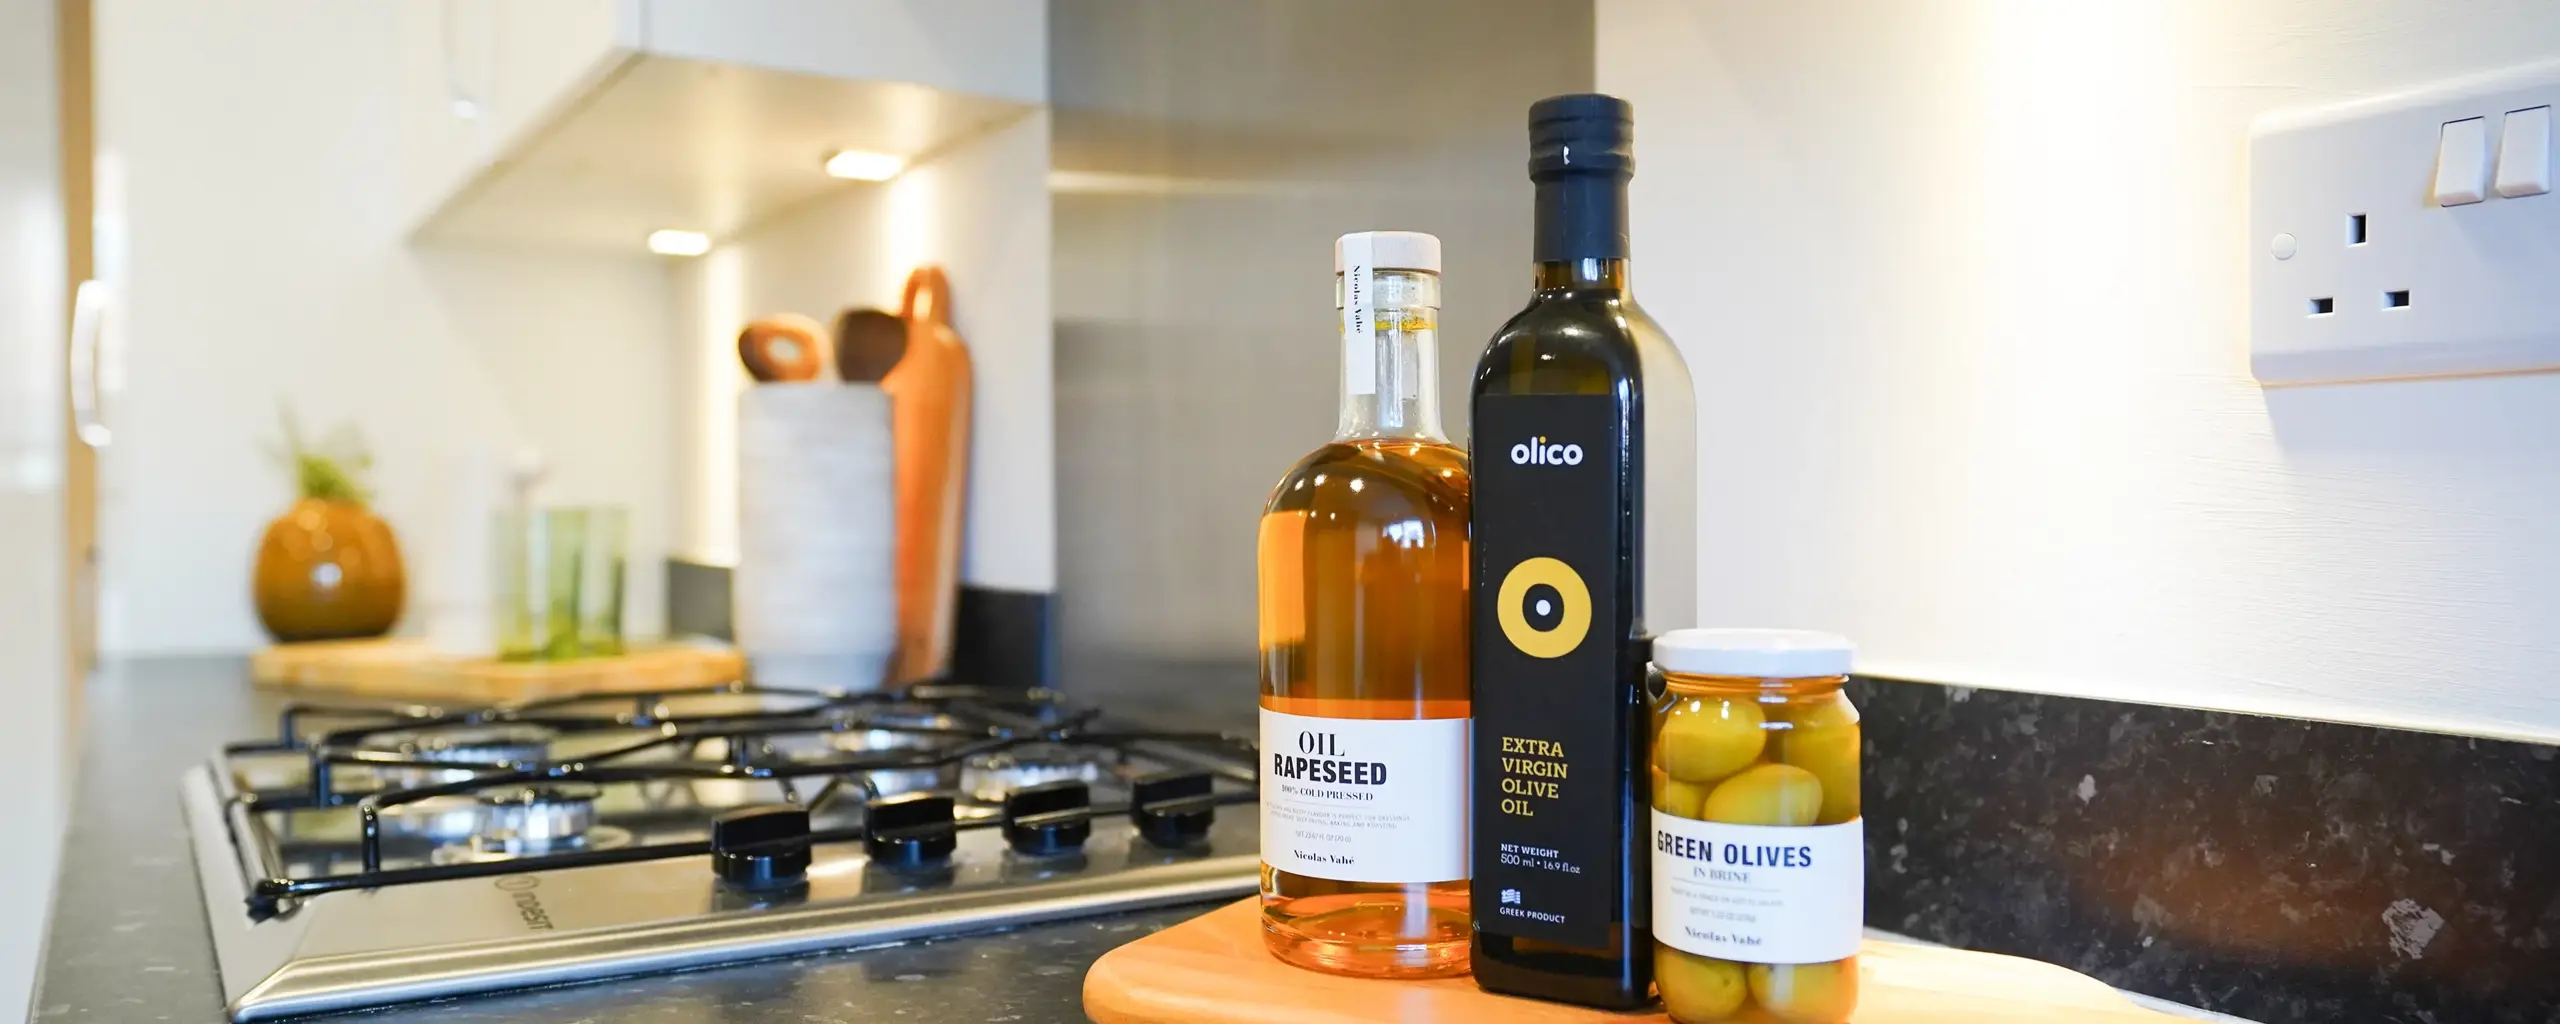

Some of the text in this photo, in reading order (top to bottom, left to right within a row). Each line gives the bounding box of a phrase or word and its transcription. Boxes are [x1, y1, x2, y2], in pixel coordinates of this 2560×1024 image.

[1355, 309, 1363, 334] Vahé
[1511, 436, 1583, 465] olico
[1299, 731, 1346, 756] OIL
[1502, 736, 1564, 757] EXTRA
[1274, 753, 1387, 785] RAPESEED
[1502, 757, 1568, 779] VIRGIN
[1282, 784, 1373, 801] 100% COLD PRESSED
[1502, 778, 1559, 799] OLIVE
[1501, 799, 1534, 816] OIL
[1294, 850, 1355, 865] Nicolas Vahé
[1501, 843, 1559, 858] NET WEIGHT
[1657, 830, 1812, 868] GREEN OLIVES
[1501, 853, 1520, 865] 500
[1523, 857, 1534, 867] ml
[1544, 860, 1560, 871] 16.9
[1693, 867, 1750, 883] IN BRINE
[1500, 906, 1565, 924] GREEK PRODUCT
[1684, 925, 1762, 945] Nicolas Vahé
